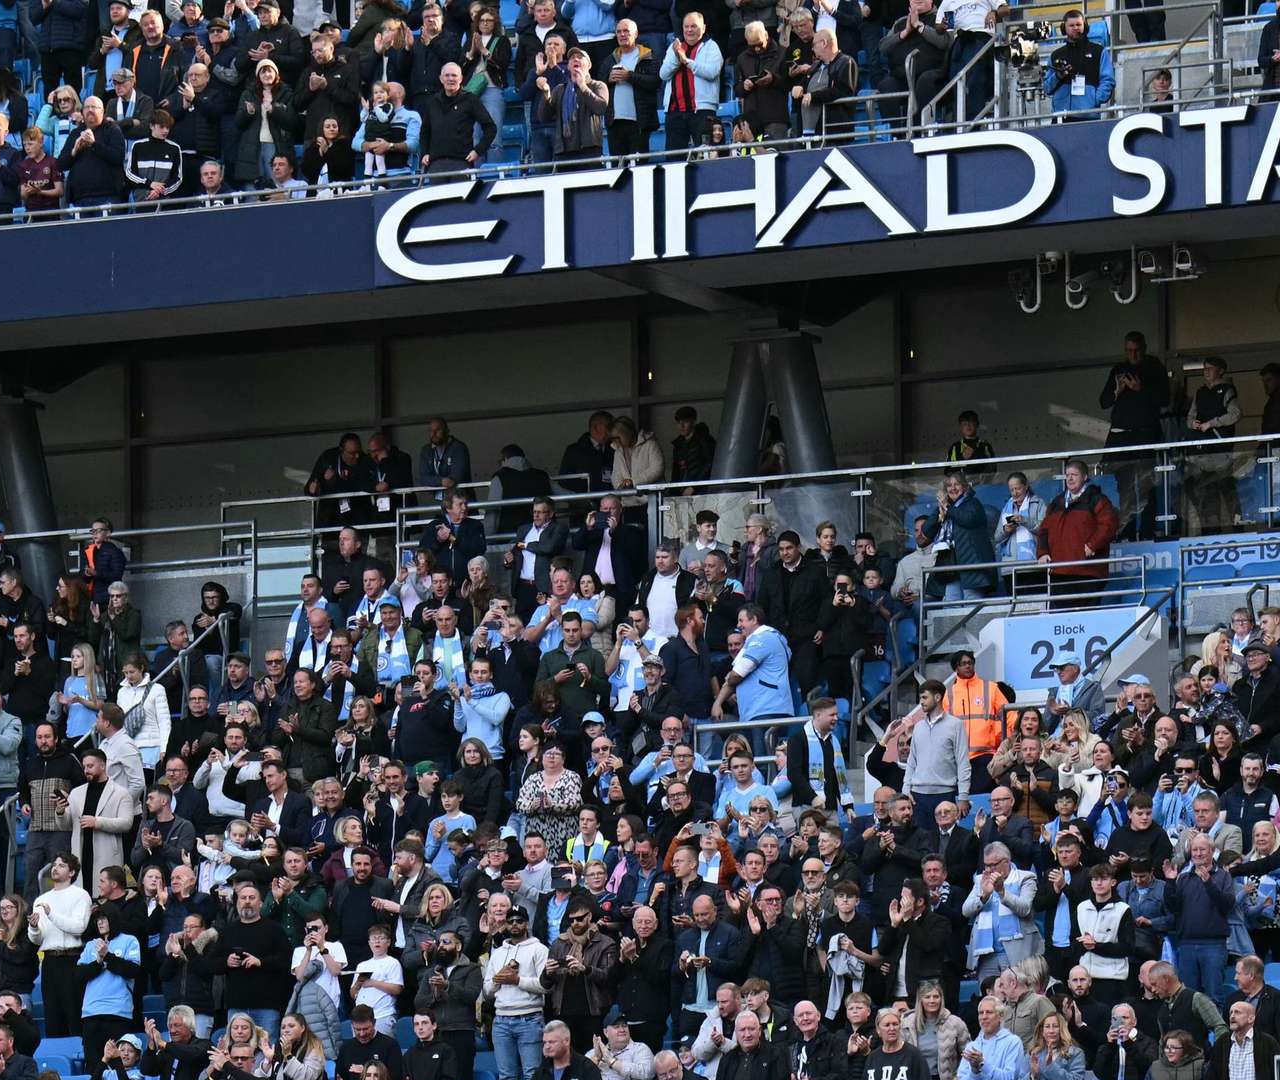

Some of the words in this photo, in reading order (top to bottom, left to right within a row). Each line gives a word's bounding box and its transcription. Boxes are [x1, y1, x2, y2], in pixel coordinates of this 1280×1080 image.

[377, 131, 1055, 280] ETIHAD
[1054, 624, 1085, 636] Block
[873, 644, 884, 656] 16
[1031, 635, 1108, 679] 216
